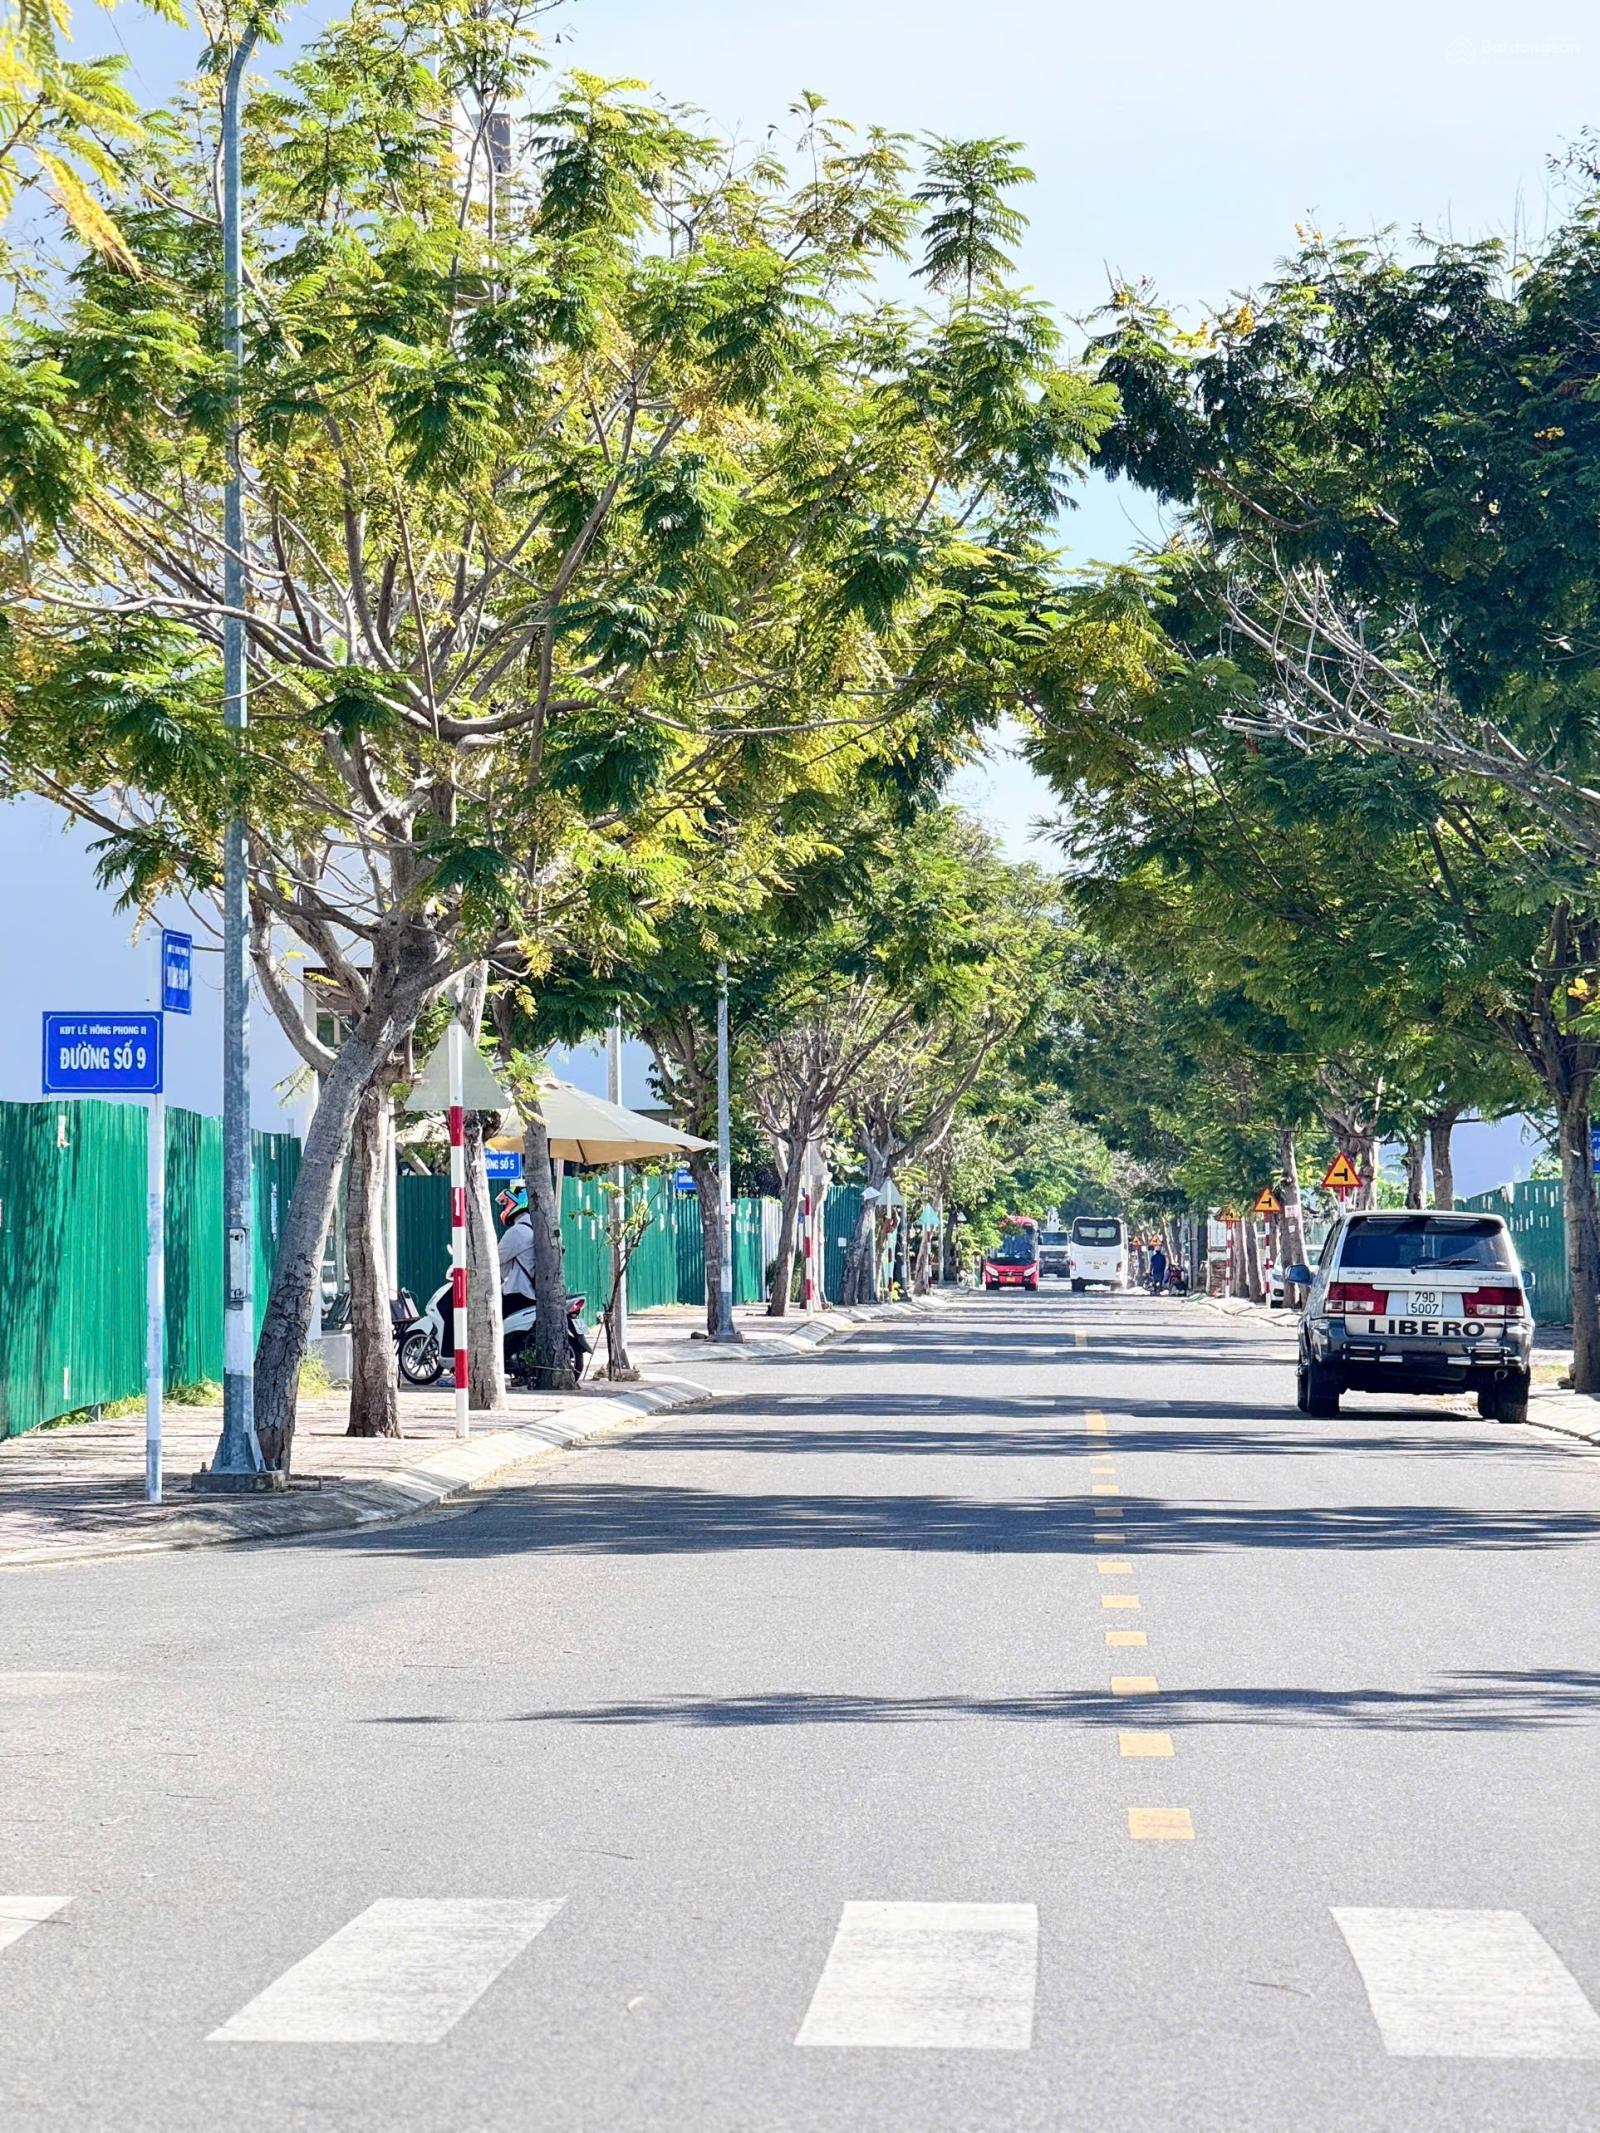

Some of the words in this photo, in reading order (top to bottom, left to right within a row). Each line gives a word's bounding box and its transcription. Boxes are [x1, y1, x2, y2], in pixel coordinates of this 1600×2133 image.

[59, 1026, 76, 1035] KĐT
[78, 1024, 88, 1035] LÊ
[113, 1026, 139, 1035] PHONG
[59, 1041, 110, 1070] ĐƯỜNG
[113, 1039, 134, 1070] SỐ
[136, 1046, 147, 1070] 9
[1415, 1291, 1436, 1303] 79D
[1411, 1303, 1439, 1314] 5007
[1368, 1319, 1485, 1337] LIBERO
